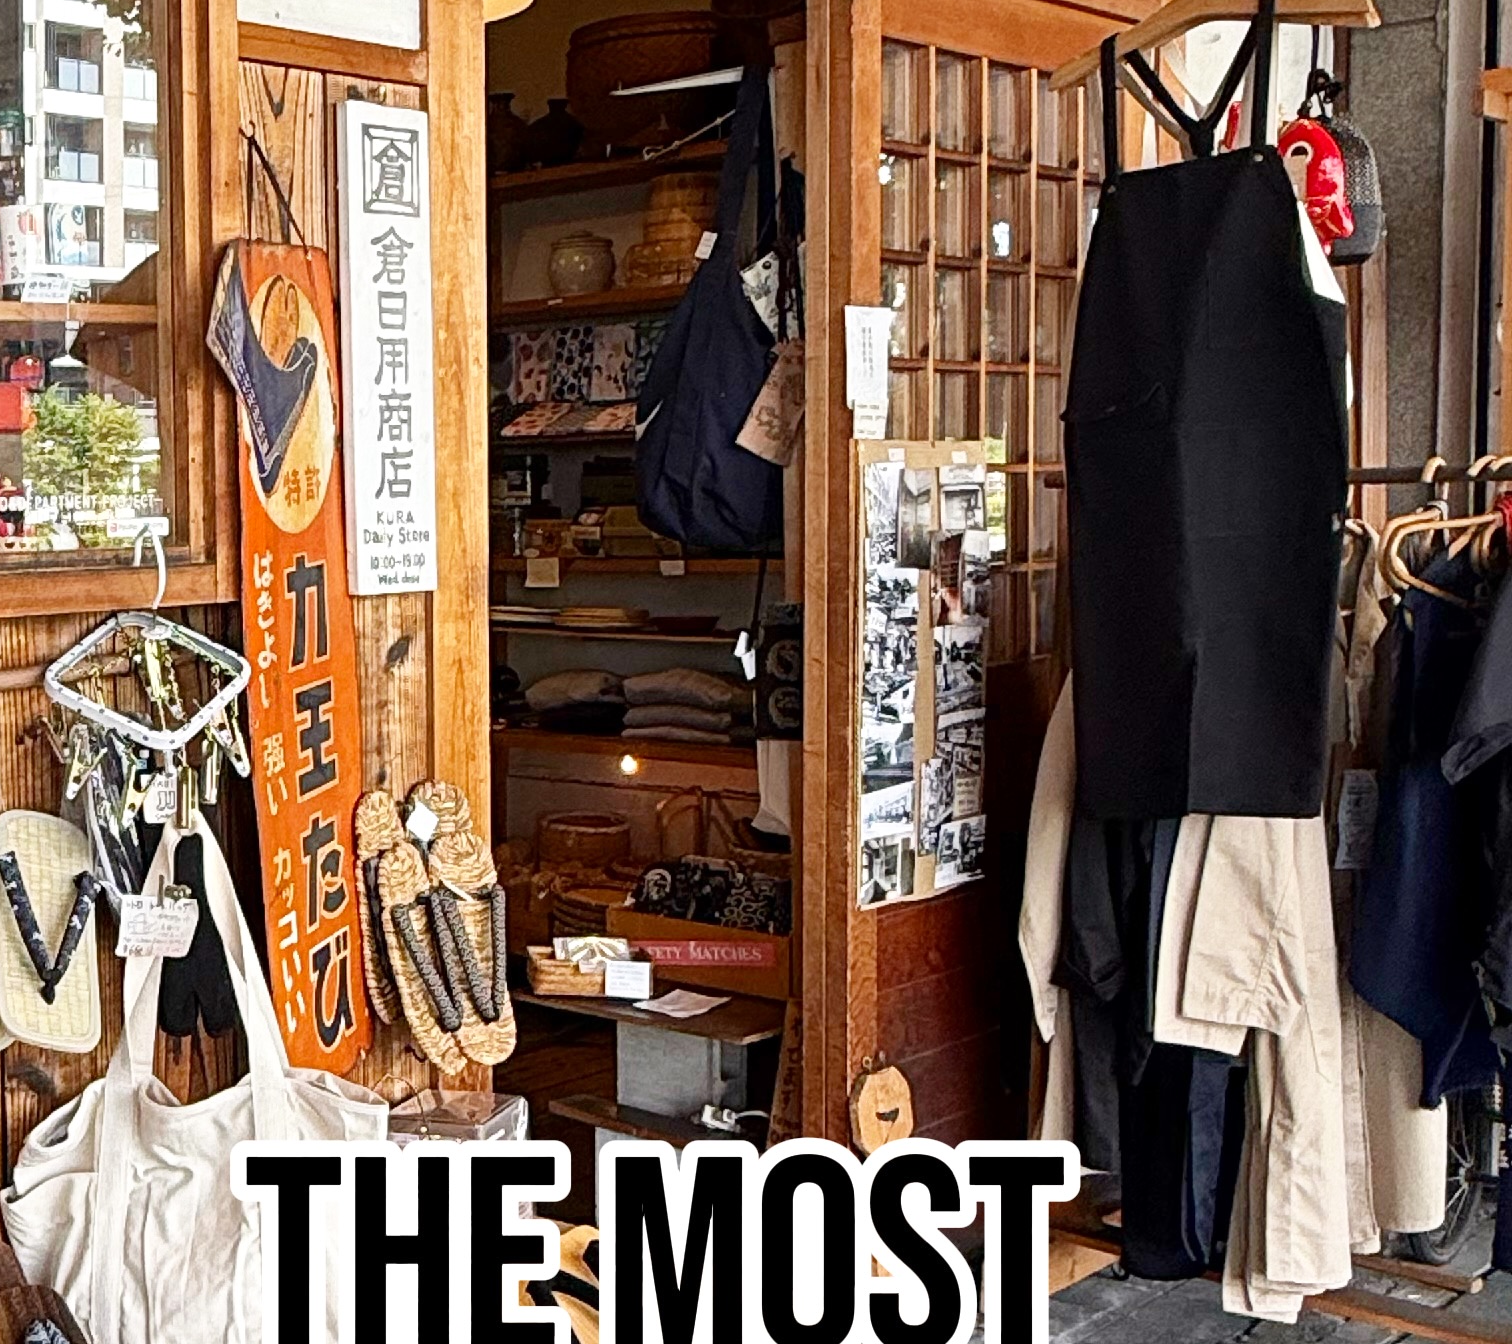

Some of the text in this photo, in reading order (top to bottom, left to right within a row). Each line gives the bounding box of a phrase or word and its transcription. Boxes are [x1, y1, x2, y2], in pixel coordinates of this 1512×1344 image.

[371, 226, 415, 500] 倉日用商店
[376, 510, 415, 525] KURA
[399, 527, 429, 544] Store
